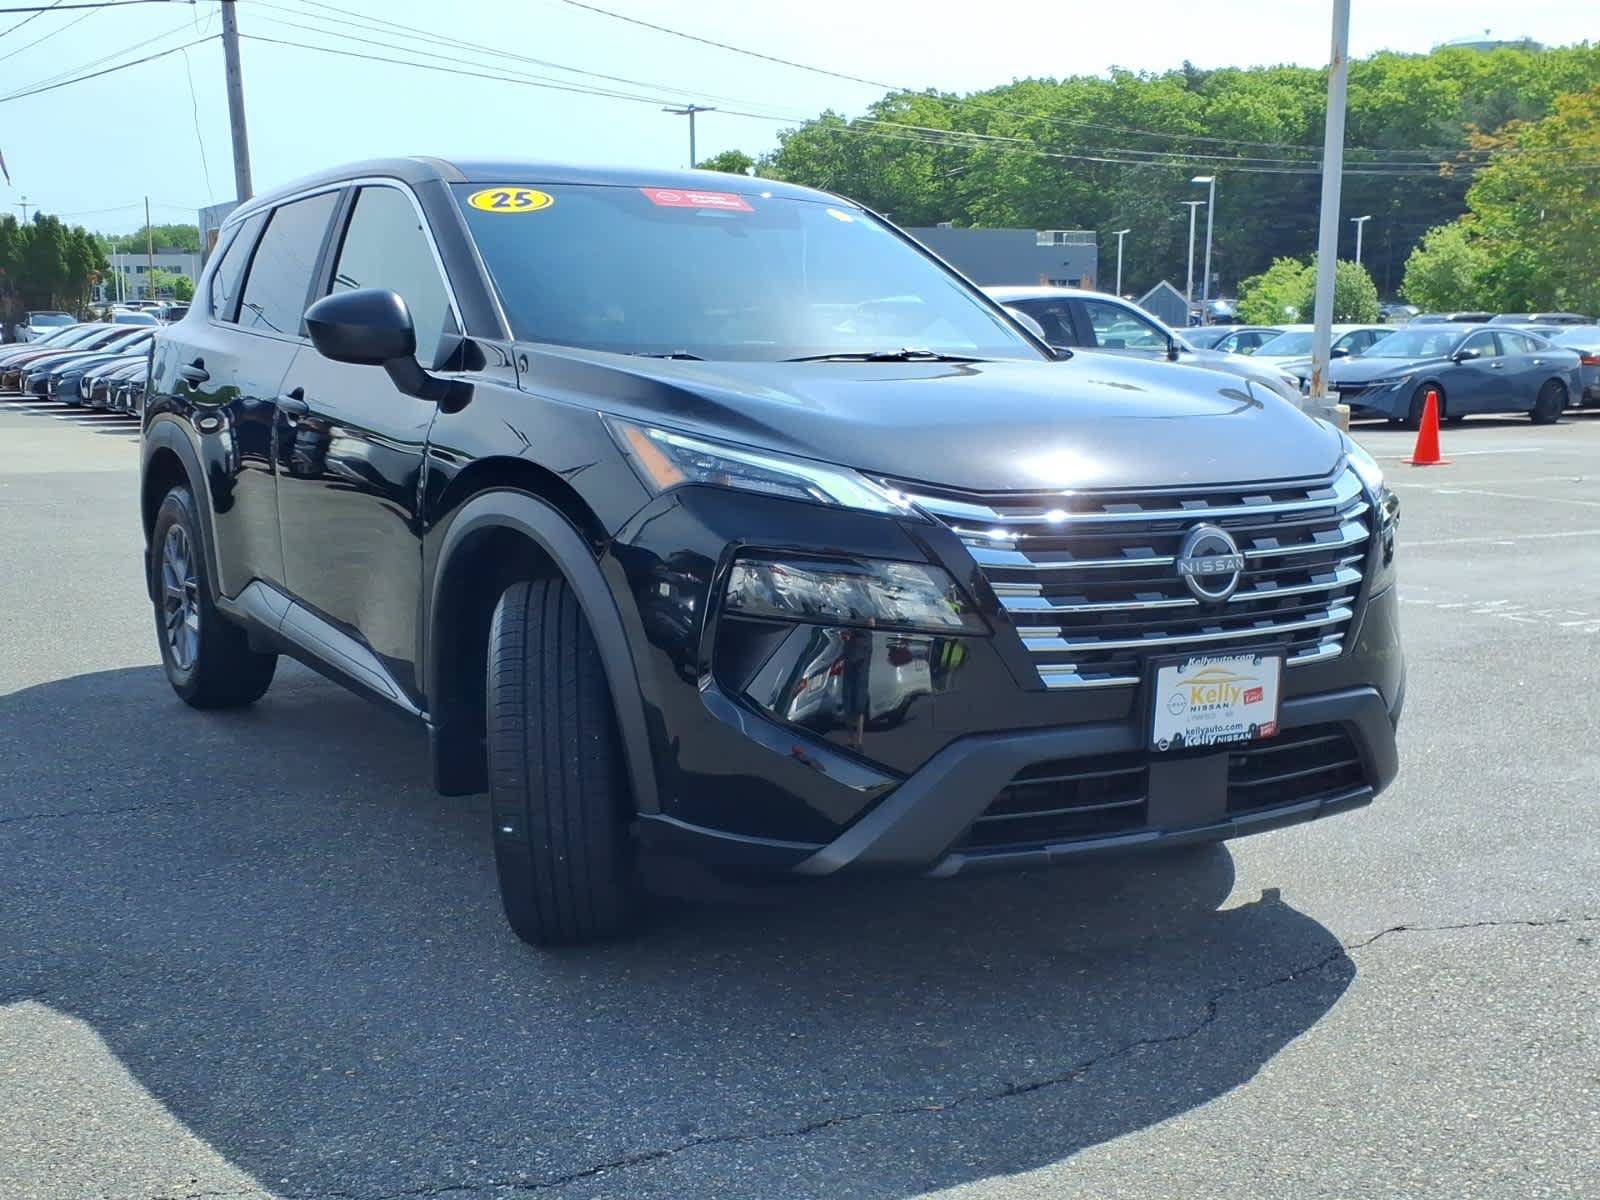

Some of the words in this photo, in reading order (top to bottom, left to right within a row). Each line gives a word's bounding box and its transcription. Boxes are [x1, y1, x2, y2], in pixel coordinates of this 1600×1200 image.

[490, 191, 532, 208] 25
[1180, 559, 1244, 573] NISSAN
[1191, 682, 1241, 706] Kelly
[1191, 702, 1229, 712] NISSAN
[1185, 723, 1244, 736] kellyauto.com
[1184, 734, 1216, 748] Kelly
[1217, 732, 1252, 744] NISSAN
